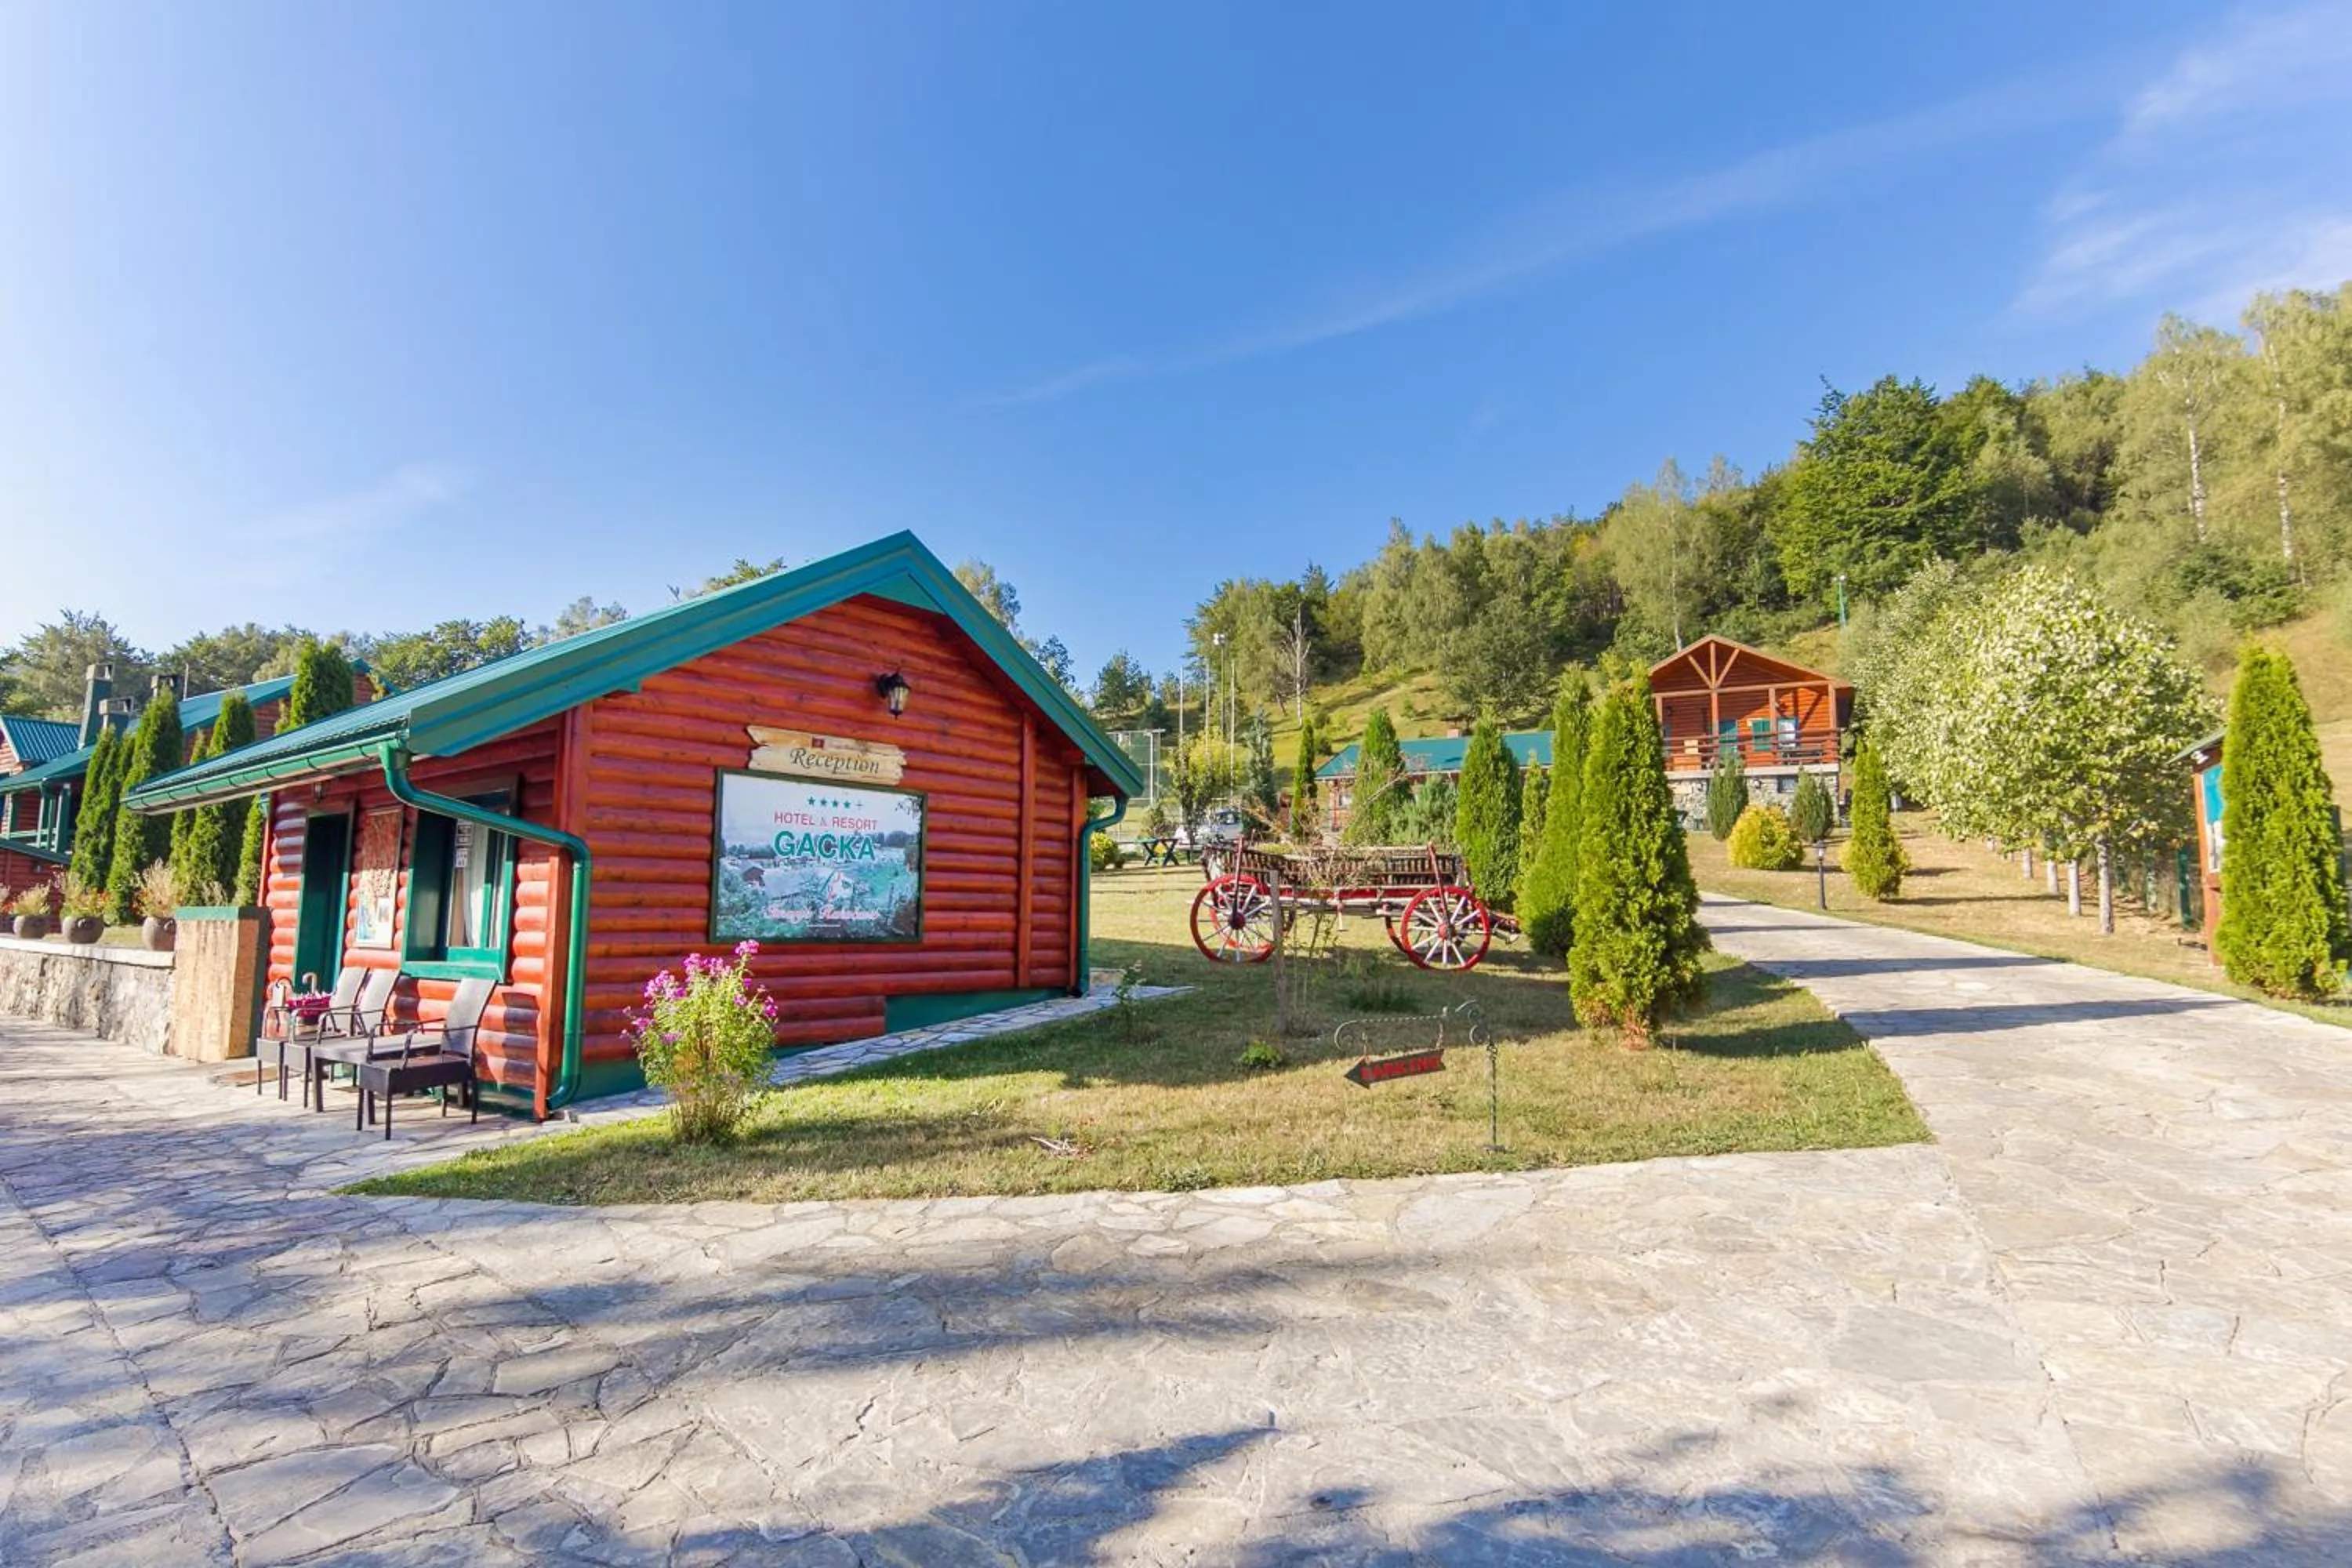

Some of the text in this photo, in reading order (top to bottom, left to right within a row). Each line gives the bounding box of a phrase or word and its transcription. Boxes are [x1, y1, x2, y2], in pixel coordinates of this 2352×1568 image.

[790, 747, 880, 774] Reception
[774, 811, 815, 826] HOTEL
[832, 816, 878, 830] RESORT
[774, 830, 876, 861] GACKA
